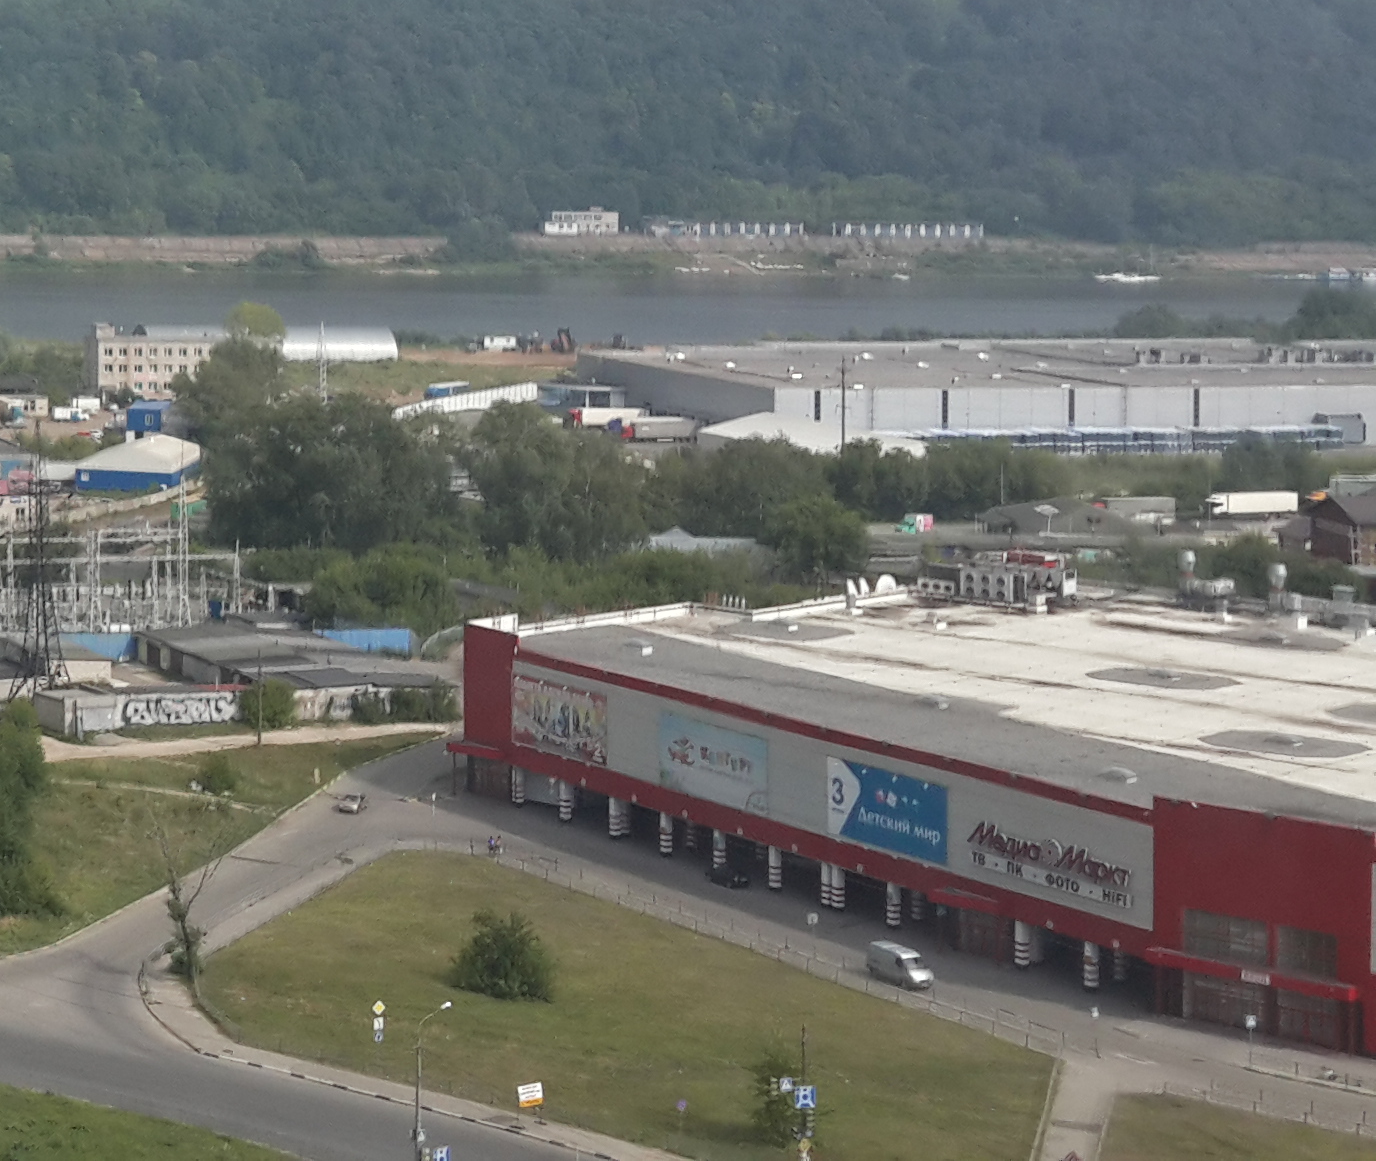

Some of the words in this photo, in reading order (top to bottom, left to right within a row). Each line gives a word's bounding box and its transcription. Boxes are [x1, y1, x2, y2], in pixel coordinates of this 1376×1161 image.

[832, 778, 844, 805] 3
[858, 806, 910, 835] Детский
[913, 825, 940, 847] мир
[967, 820, 1043, 861] Медиа
[1054, 843, 1132, 887] Маркт
[971, 851, 986, 866] ТВ
[1006, 860, 1024, 878] ПК
[1044, 873, 1080, 894] ФОТО
